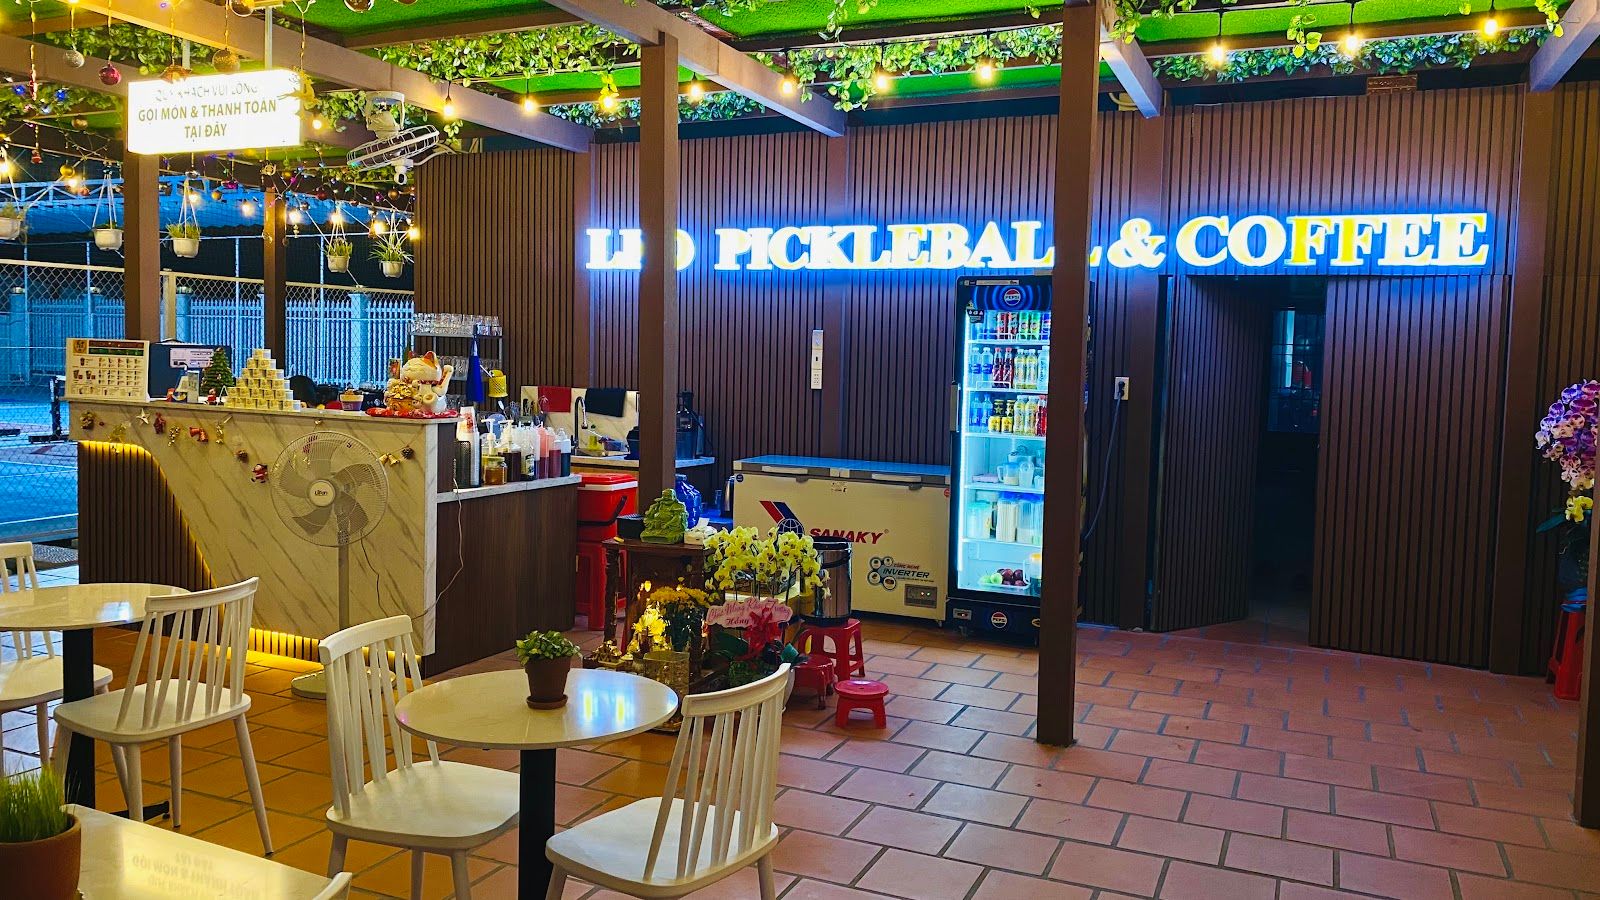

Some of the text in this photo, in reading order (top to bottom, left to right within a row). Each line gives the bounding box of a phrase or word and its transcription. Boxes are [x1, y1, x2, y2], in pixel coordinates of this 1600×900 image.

[190, 106, 199, 118] &
[201, 102, 241, 117] THANH
[184, 124, 201, 142] TẠI
[714, 220, 1100, 271] PICKLEBAL
[1106, 218, 1166, 269] &
[1176, 213, 1489, 267] COFFEE
[809, 528, 884, 544] SANAKY
[882, 568, 930, 578] INVERTER
